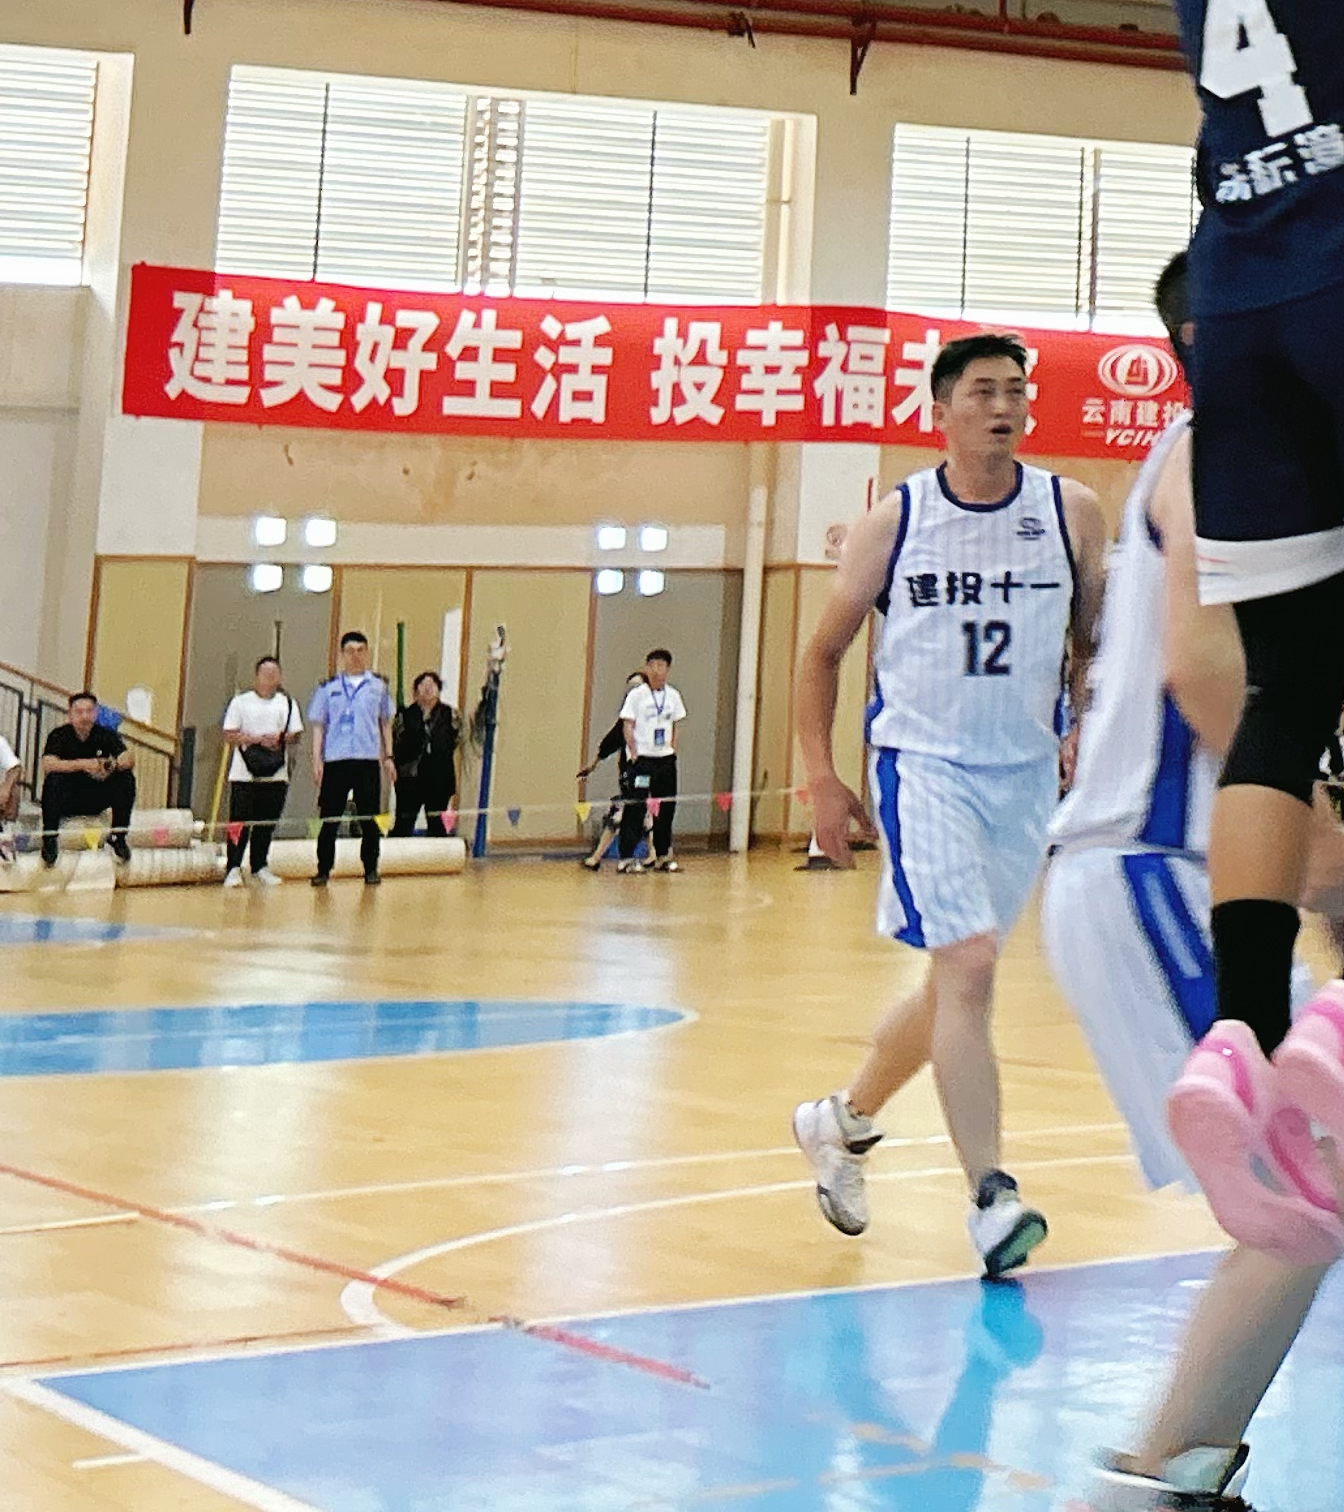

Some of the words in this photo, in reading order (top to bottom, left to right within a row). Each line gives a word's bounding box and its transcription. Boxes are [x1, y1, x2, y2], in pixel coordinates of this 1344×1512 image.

[164, 288, 614, 424] 建美好生活
[904, 571, 1061, 607] 建投十一
[961, 619, 1011, 676] 12
